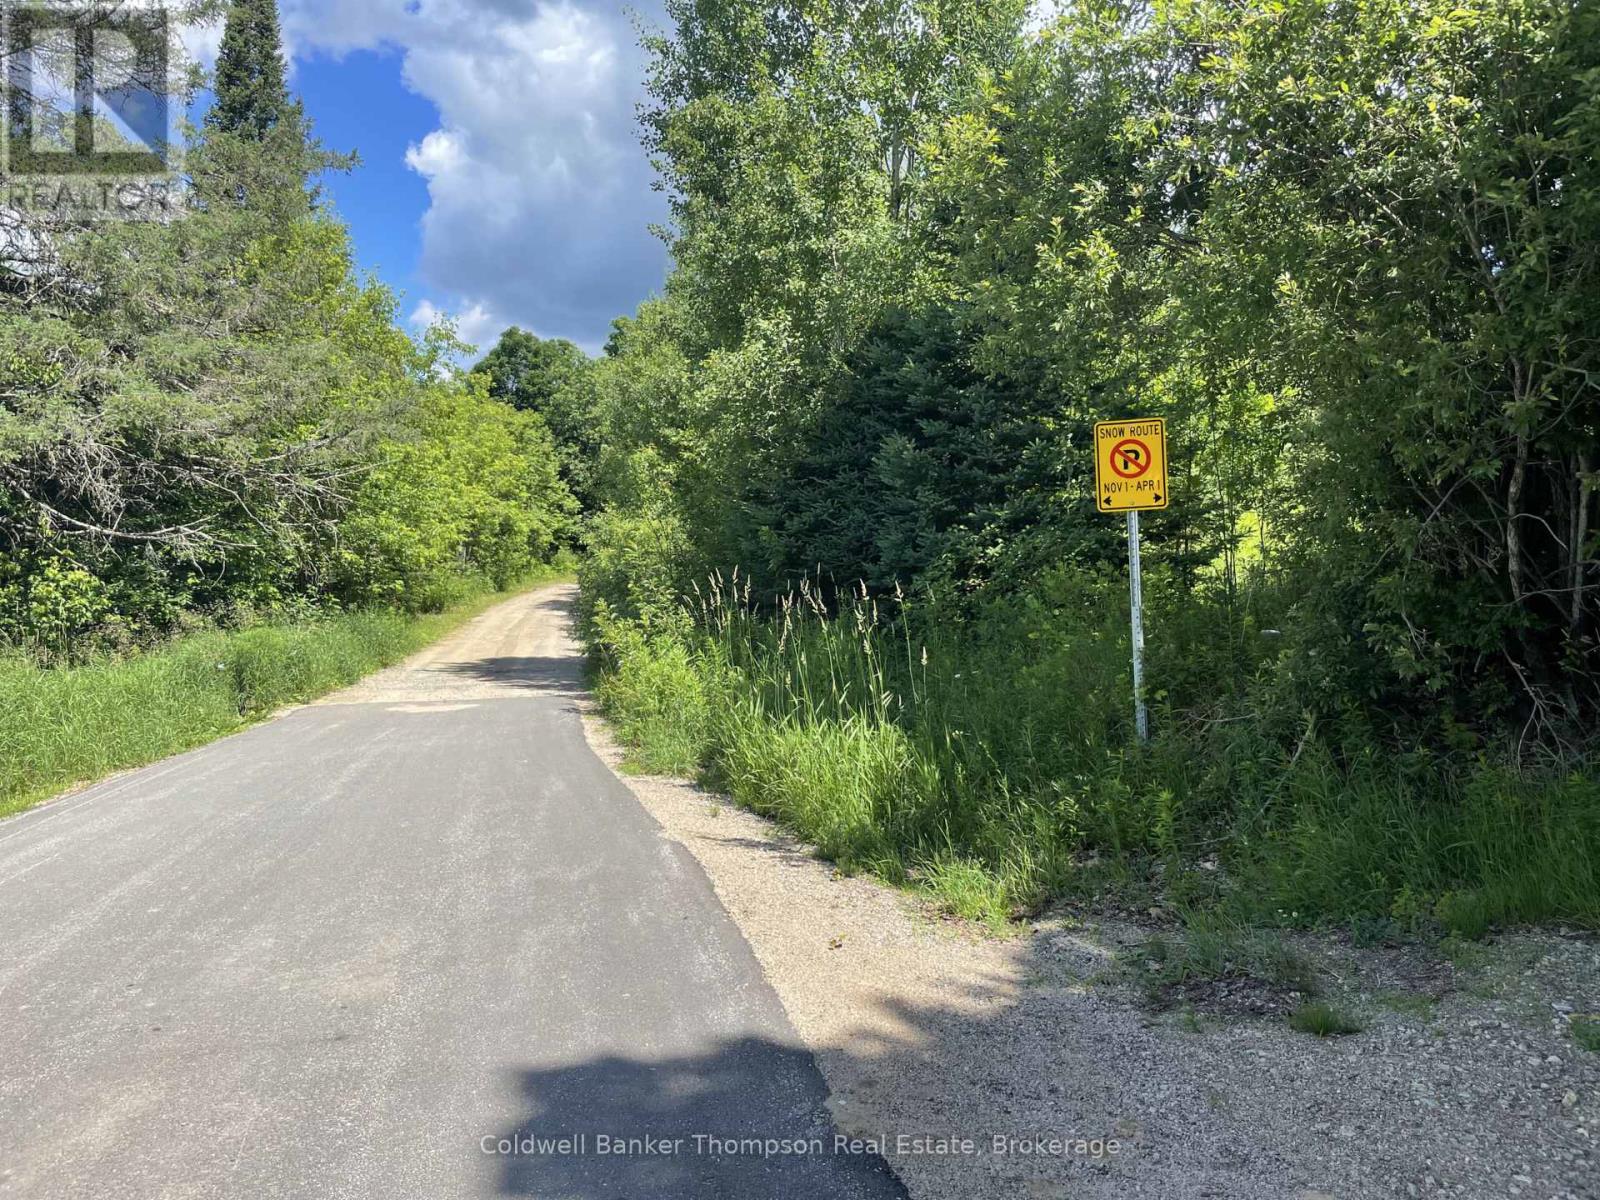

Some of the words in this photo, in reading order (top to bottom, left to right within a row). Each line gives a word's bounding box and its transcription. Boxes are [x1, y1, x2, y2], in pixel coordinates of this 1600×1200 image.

[1100, 427, 1125, 439] SNOW
[1129, 424, 1160, 436] ROUTE
[1104, 482, 1122, 493] NOV
[1136, 480, 1155, 491] APR
